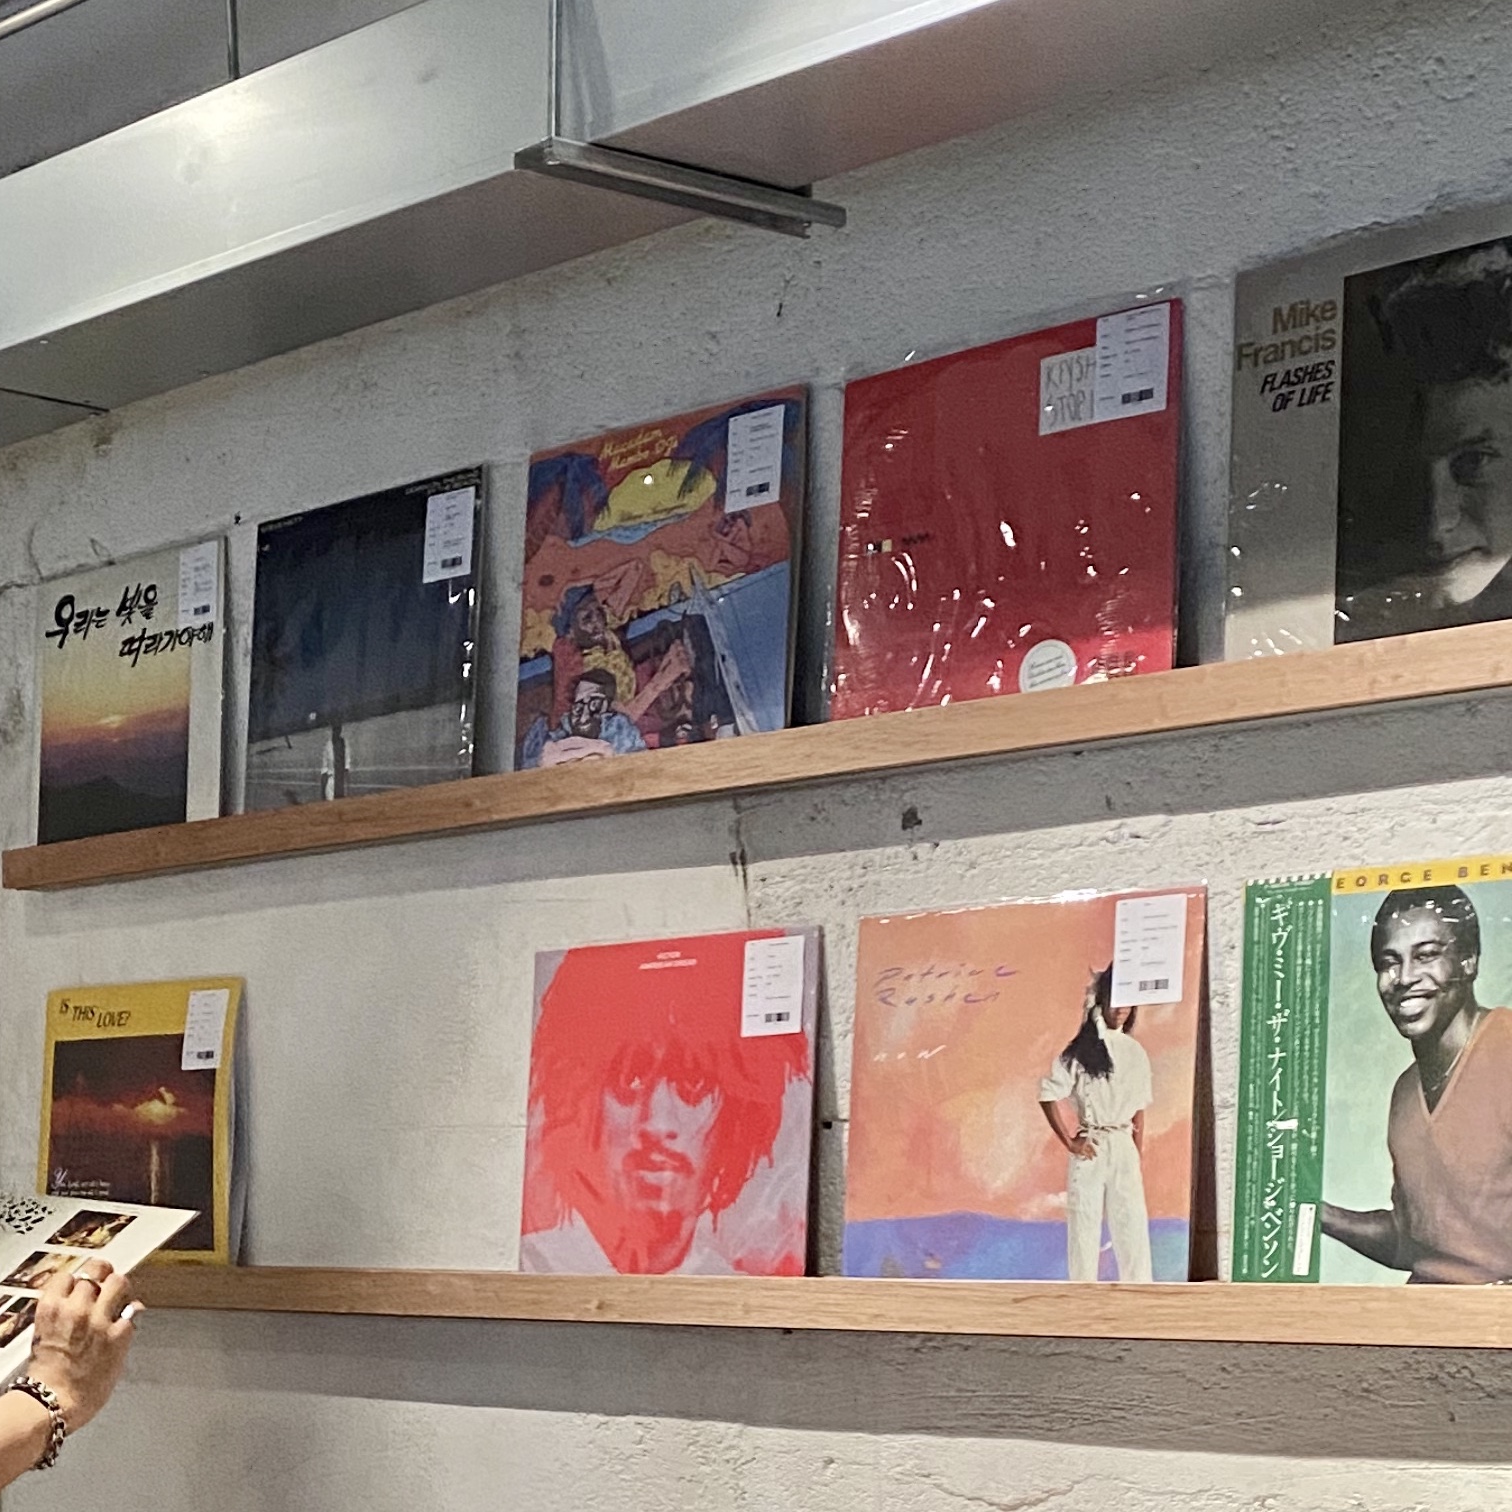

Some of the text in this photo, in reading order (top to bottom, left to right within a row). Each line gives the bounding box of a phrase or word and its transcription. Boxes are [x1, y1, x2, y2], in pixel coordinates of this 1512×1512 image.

[1272, 299, 1337, 335] Mike
[1236, 329, 1337, 371] Francis
[1260, 360, 1336, 395] FLASHES
[1272, 382, 1335, 412] OF LIFE
[115, 583, 159, 626] 빛을
[73, 1005, 99, 1021] THIS
